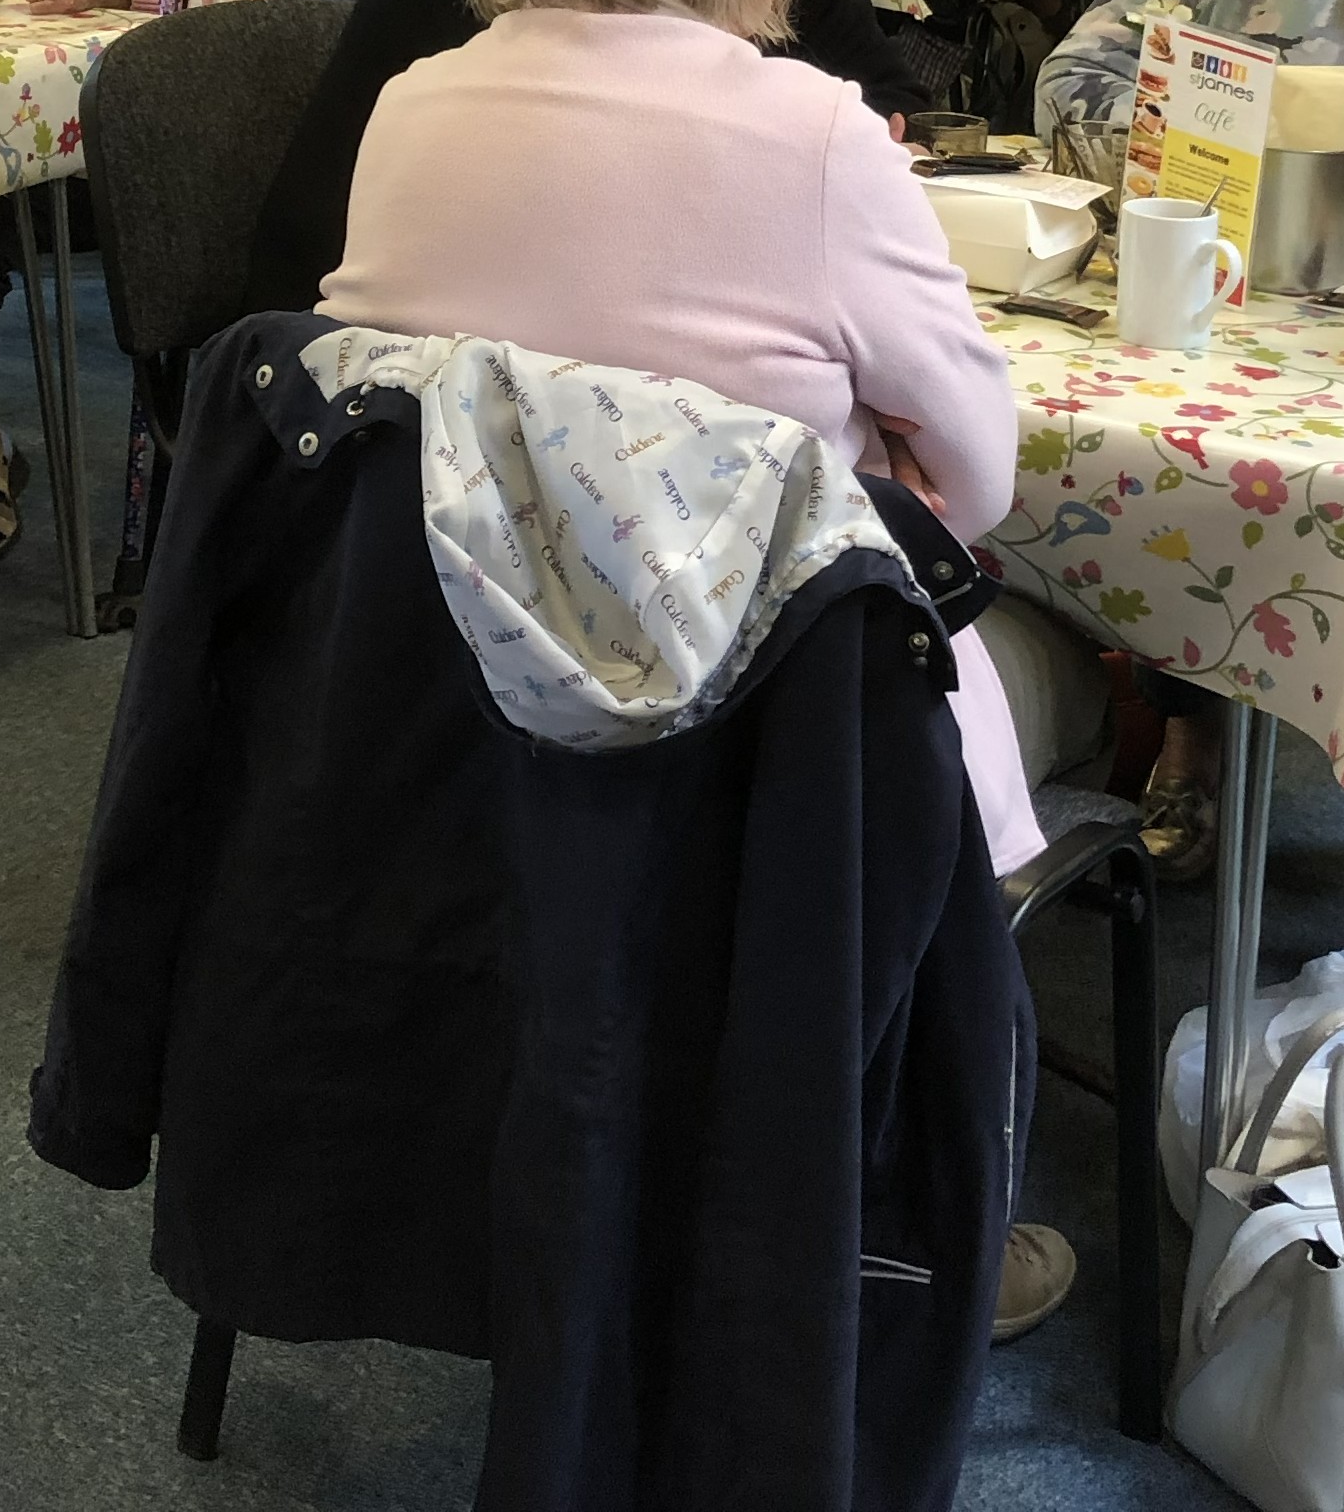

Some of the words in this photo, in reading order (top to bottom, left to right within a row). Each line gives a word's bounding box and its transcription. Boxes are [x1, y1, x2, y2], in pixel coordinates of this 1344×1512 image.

[1194, 102, 1236, 132] Café
[1189, 143, 1230, 166] Welcome
[589, 384, 623, 422] Caldene
[674, 398, 710, 438] Caldene
[614, 432, 666, 462] Caldene
[570, 462, 606, 505] Caldene
[658, 468, 691, 521] Caldene
[807, 465, 825, 521] Caldene
